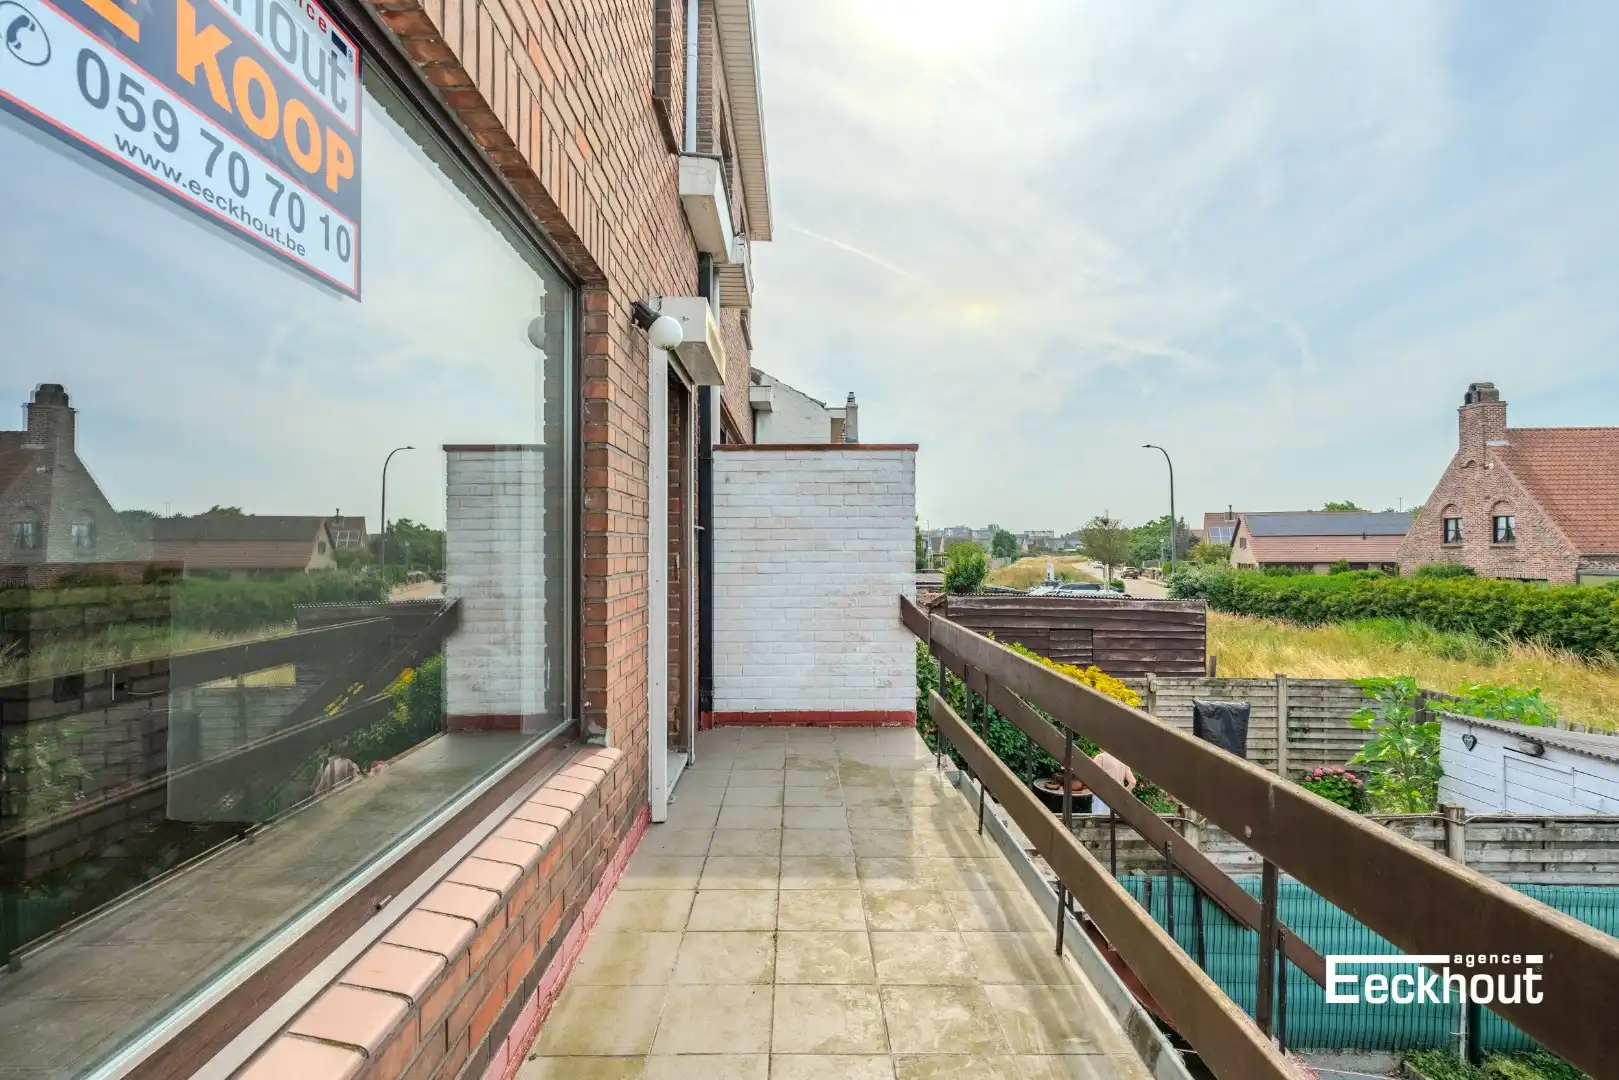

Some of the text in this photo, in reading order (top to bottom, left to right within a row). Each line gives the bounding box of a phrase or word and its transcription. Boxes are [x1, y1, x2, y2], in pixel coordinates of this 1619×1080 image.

[76, 48, 351, 263] 059 70 70 10
[176, 0, 354, 193] KOOP
[114, 133, 306, 257] www.eeckhout.be
